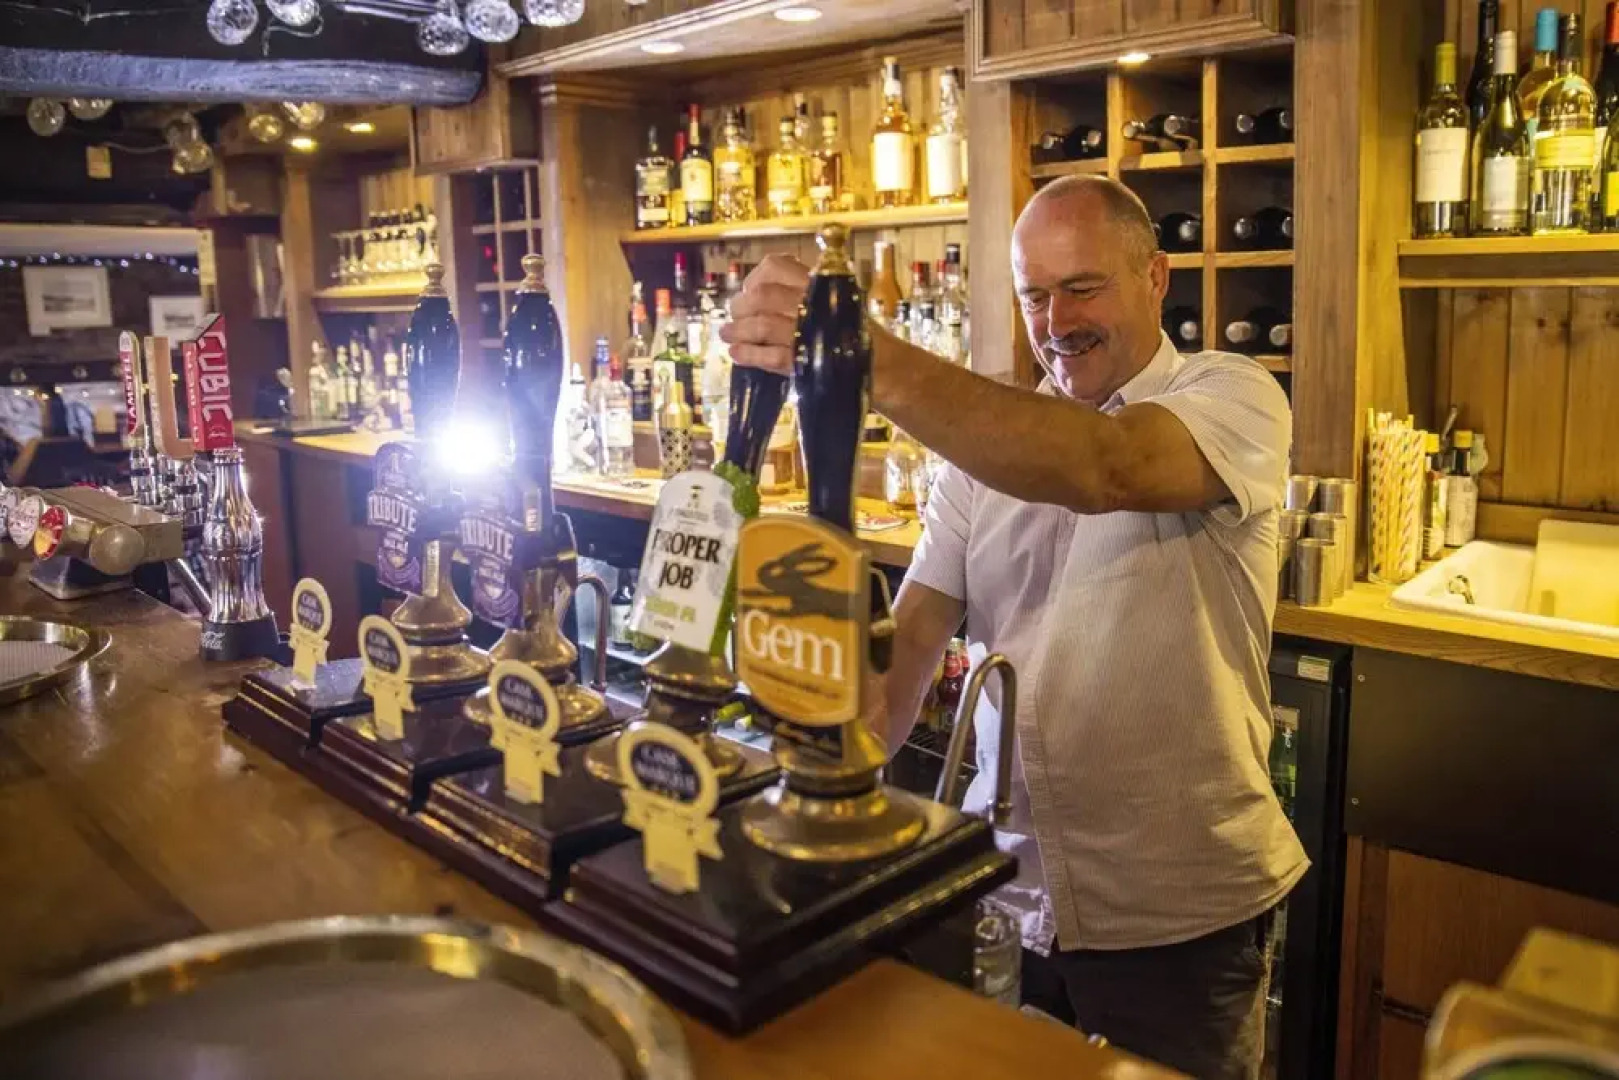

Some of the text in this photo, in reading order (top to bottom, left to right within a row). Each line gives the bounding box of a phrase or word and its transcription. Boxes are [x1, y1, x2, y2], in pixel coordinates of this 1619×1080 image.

[122, 355, 137, 418] AMSTEL
[198, 331, 233, 422] CUBIC
[368, 493, 417, 532] TRIBUTE
[460, 516, 514, 562] TRIBUTE
[652, 528, 722, 564] PROPER
[658, 561, 694, 589] JOB
[743, 608, 844, 680] Gem
